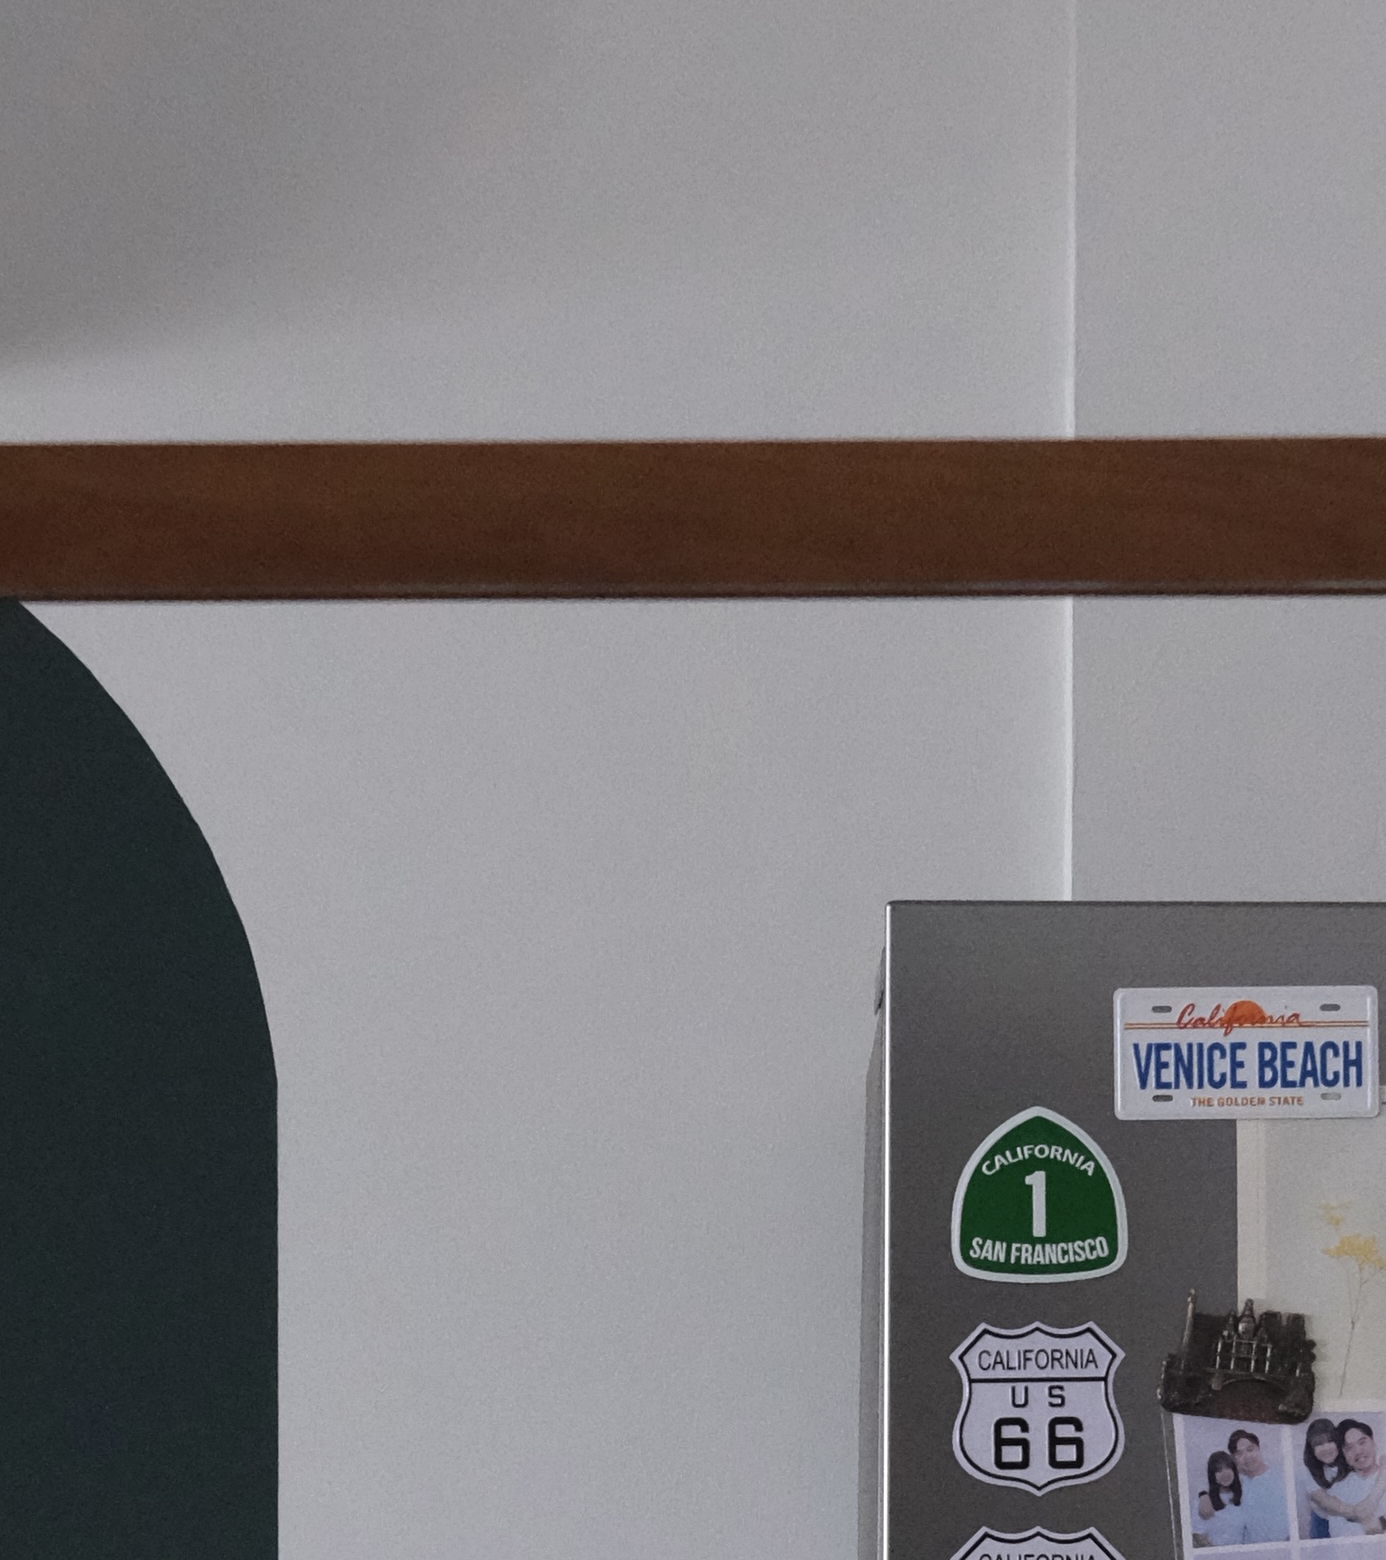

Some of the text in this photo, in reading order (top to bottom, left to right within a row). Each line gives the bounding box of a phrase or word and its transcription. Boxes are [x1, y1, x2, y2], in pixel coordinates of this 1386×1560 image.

[1175, 1004, 1304, 1037] California
[1132, 1041, 1363, 1090] VENICE BEACH
[1190, 1095, 1304, 1108] THE GOLDEN STATE
[981, 1144, 1096, 1176] CALIFORNIA
[1024, 1170, 1047, 1238] 1
[969, 1236, 1110, 1265] SAN FRANCISCO
[978, 1348, 1099, 1371] CALIFORNIA
[994, 1416, 1085, 1470] 66
